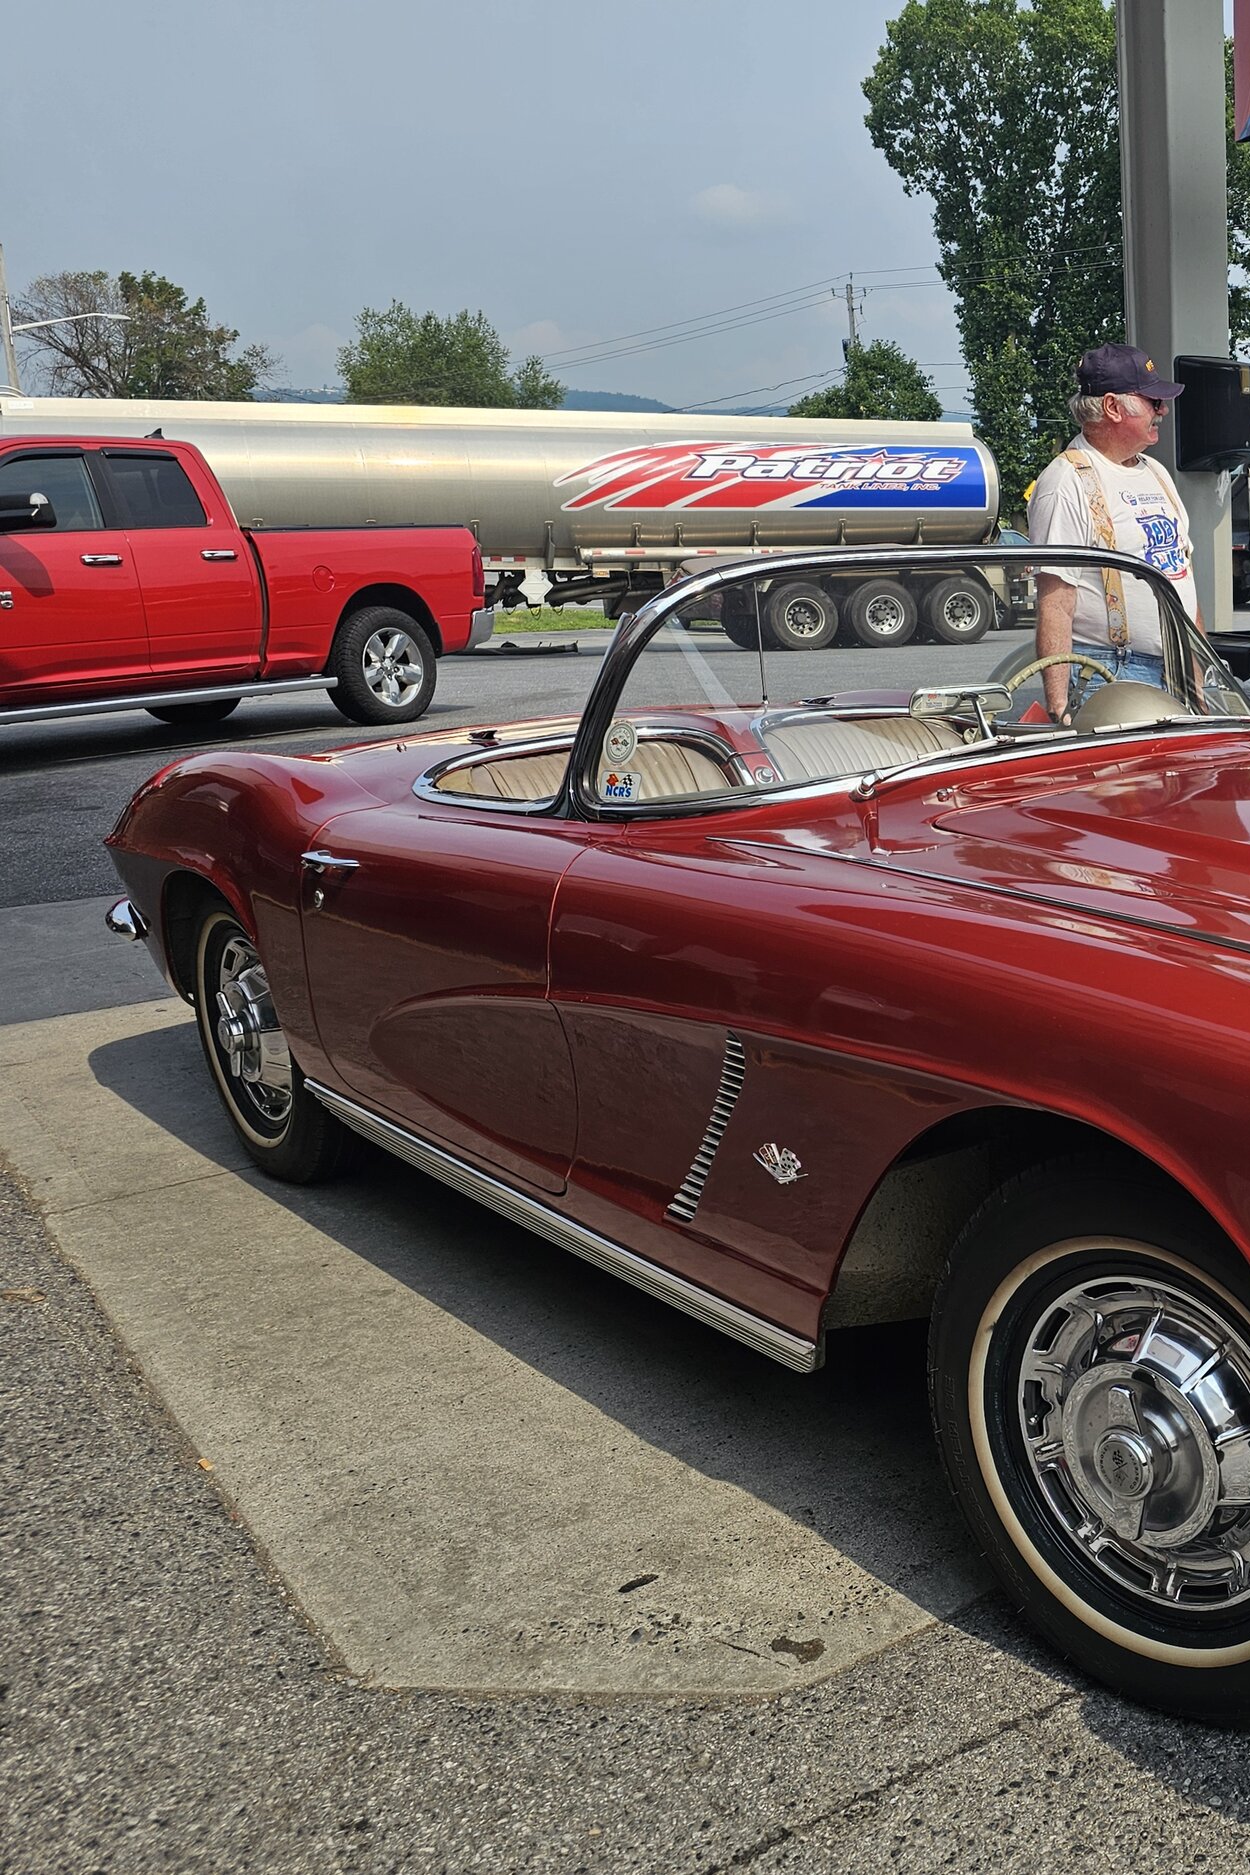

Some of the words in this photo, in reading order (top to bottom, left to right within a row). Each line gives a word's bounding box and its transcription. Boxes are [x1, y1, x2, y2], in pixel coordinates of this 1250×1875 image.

[684, 452, 967, 482] Patriot
[820, 482, 861, 491] TANK
[605, 785, 632, 798] NCRS
